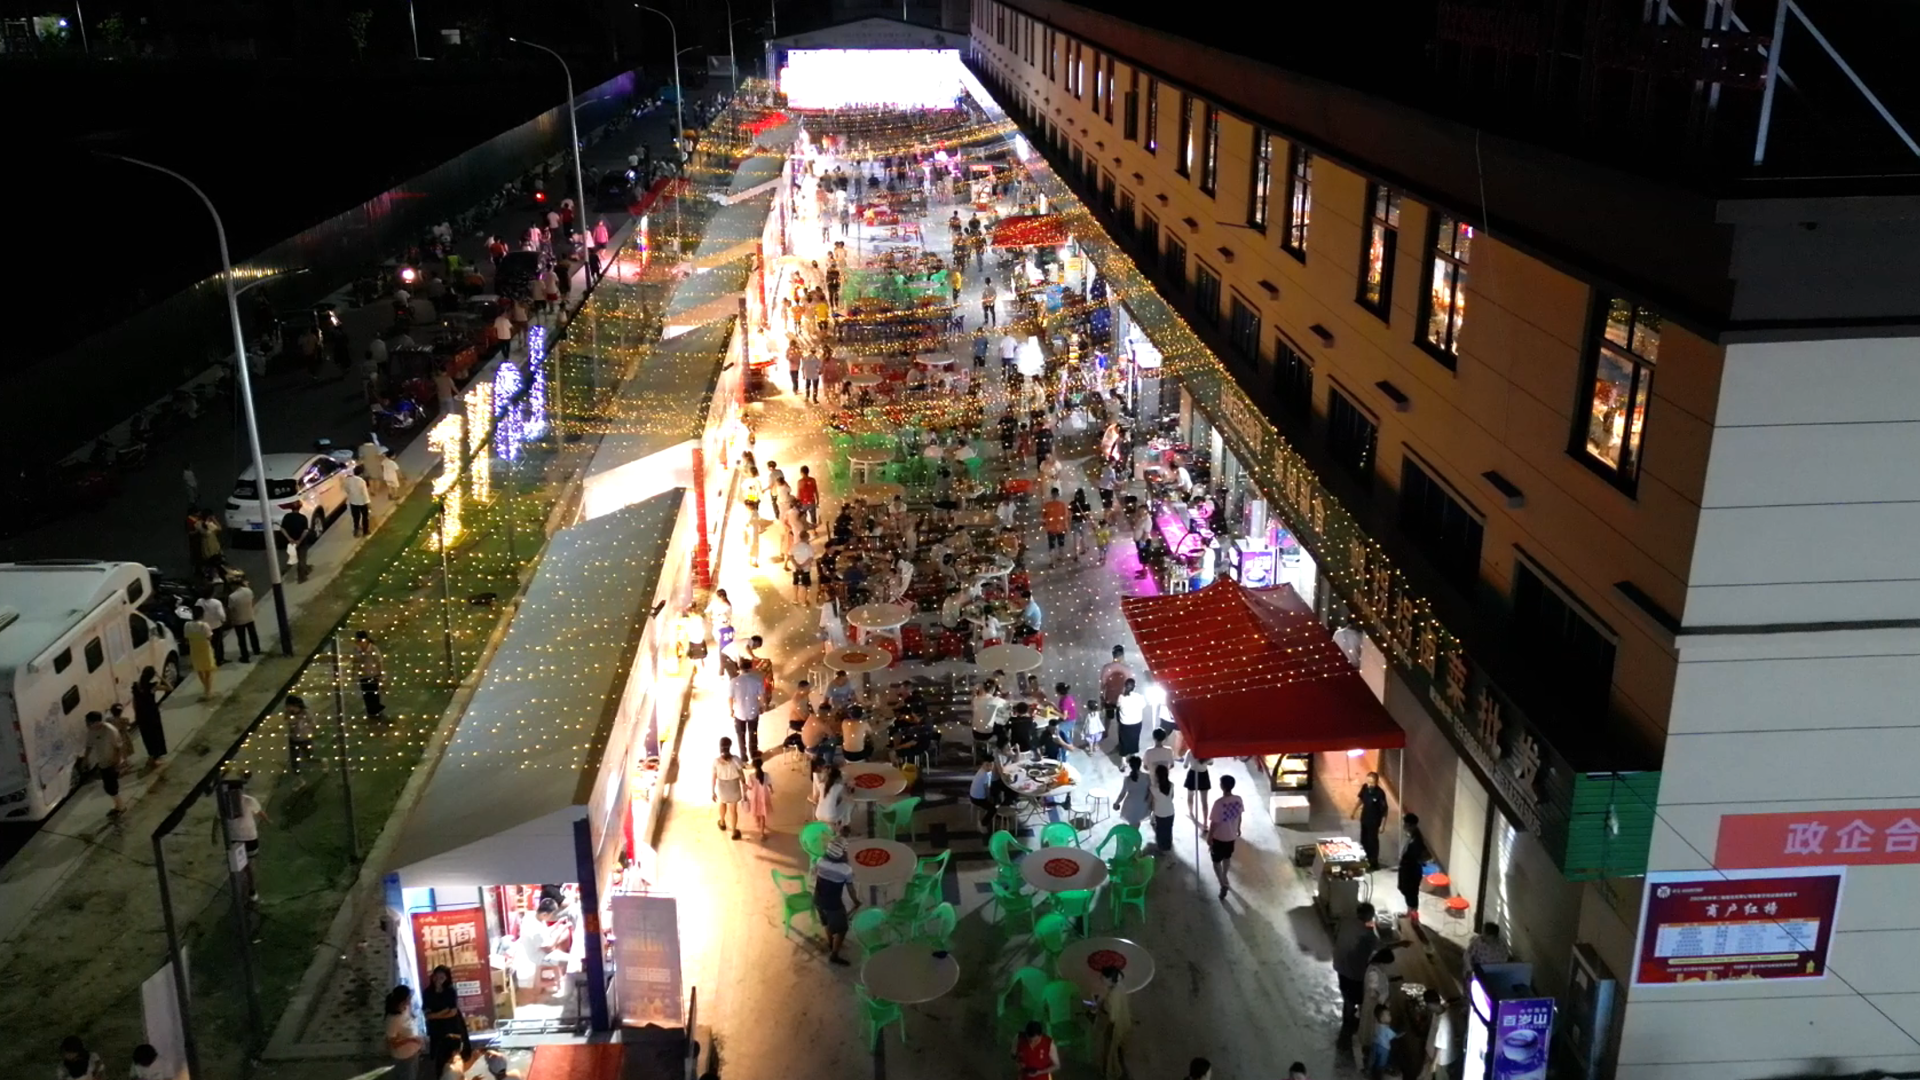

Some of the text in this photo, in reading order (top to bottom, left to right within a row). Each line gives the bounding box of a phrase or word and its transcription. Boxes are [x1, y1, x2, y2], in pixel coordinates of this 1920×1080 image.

[1784, 818, 1920, 855] 政企合
[1705, 901, 1778, 918] 商户红榜
[422, 921, 477, 949] 招商
[1503, 1014, 1547, 1027] 百岁山
